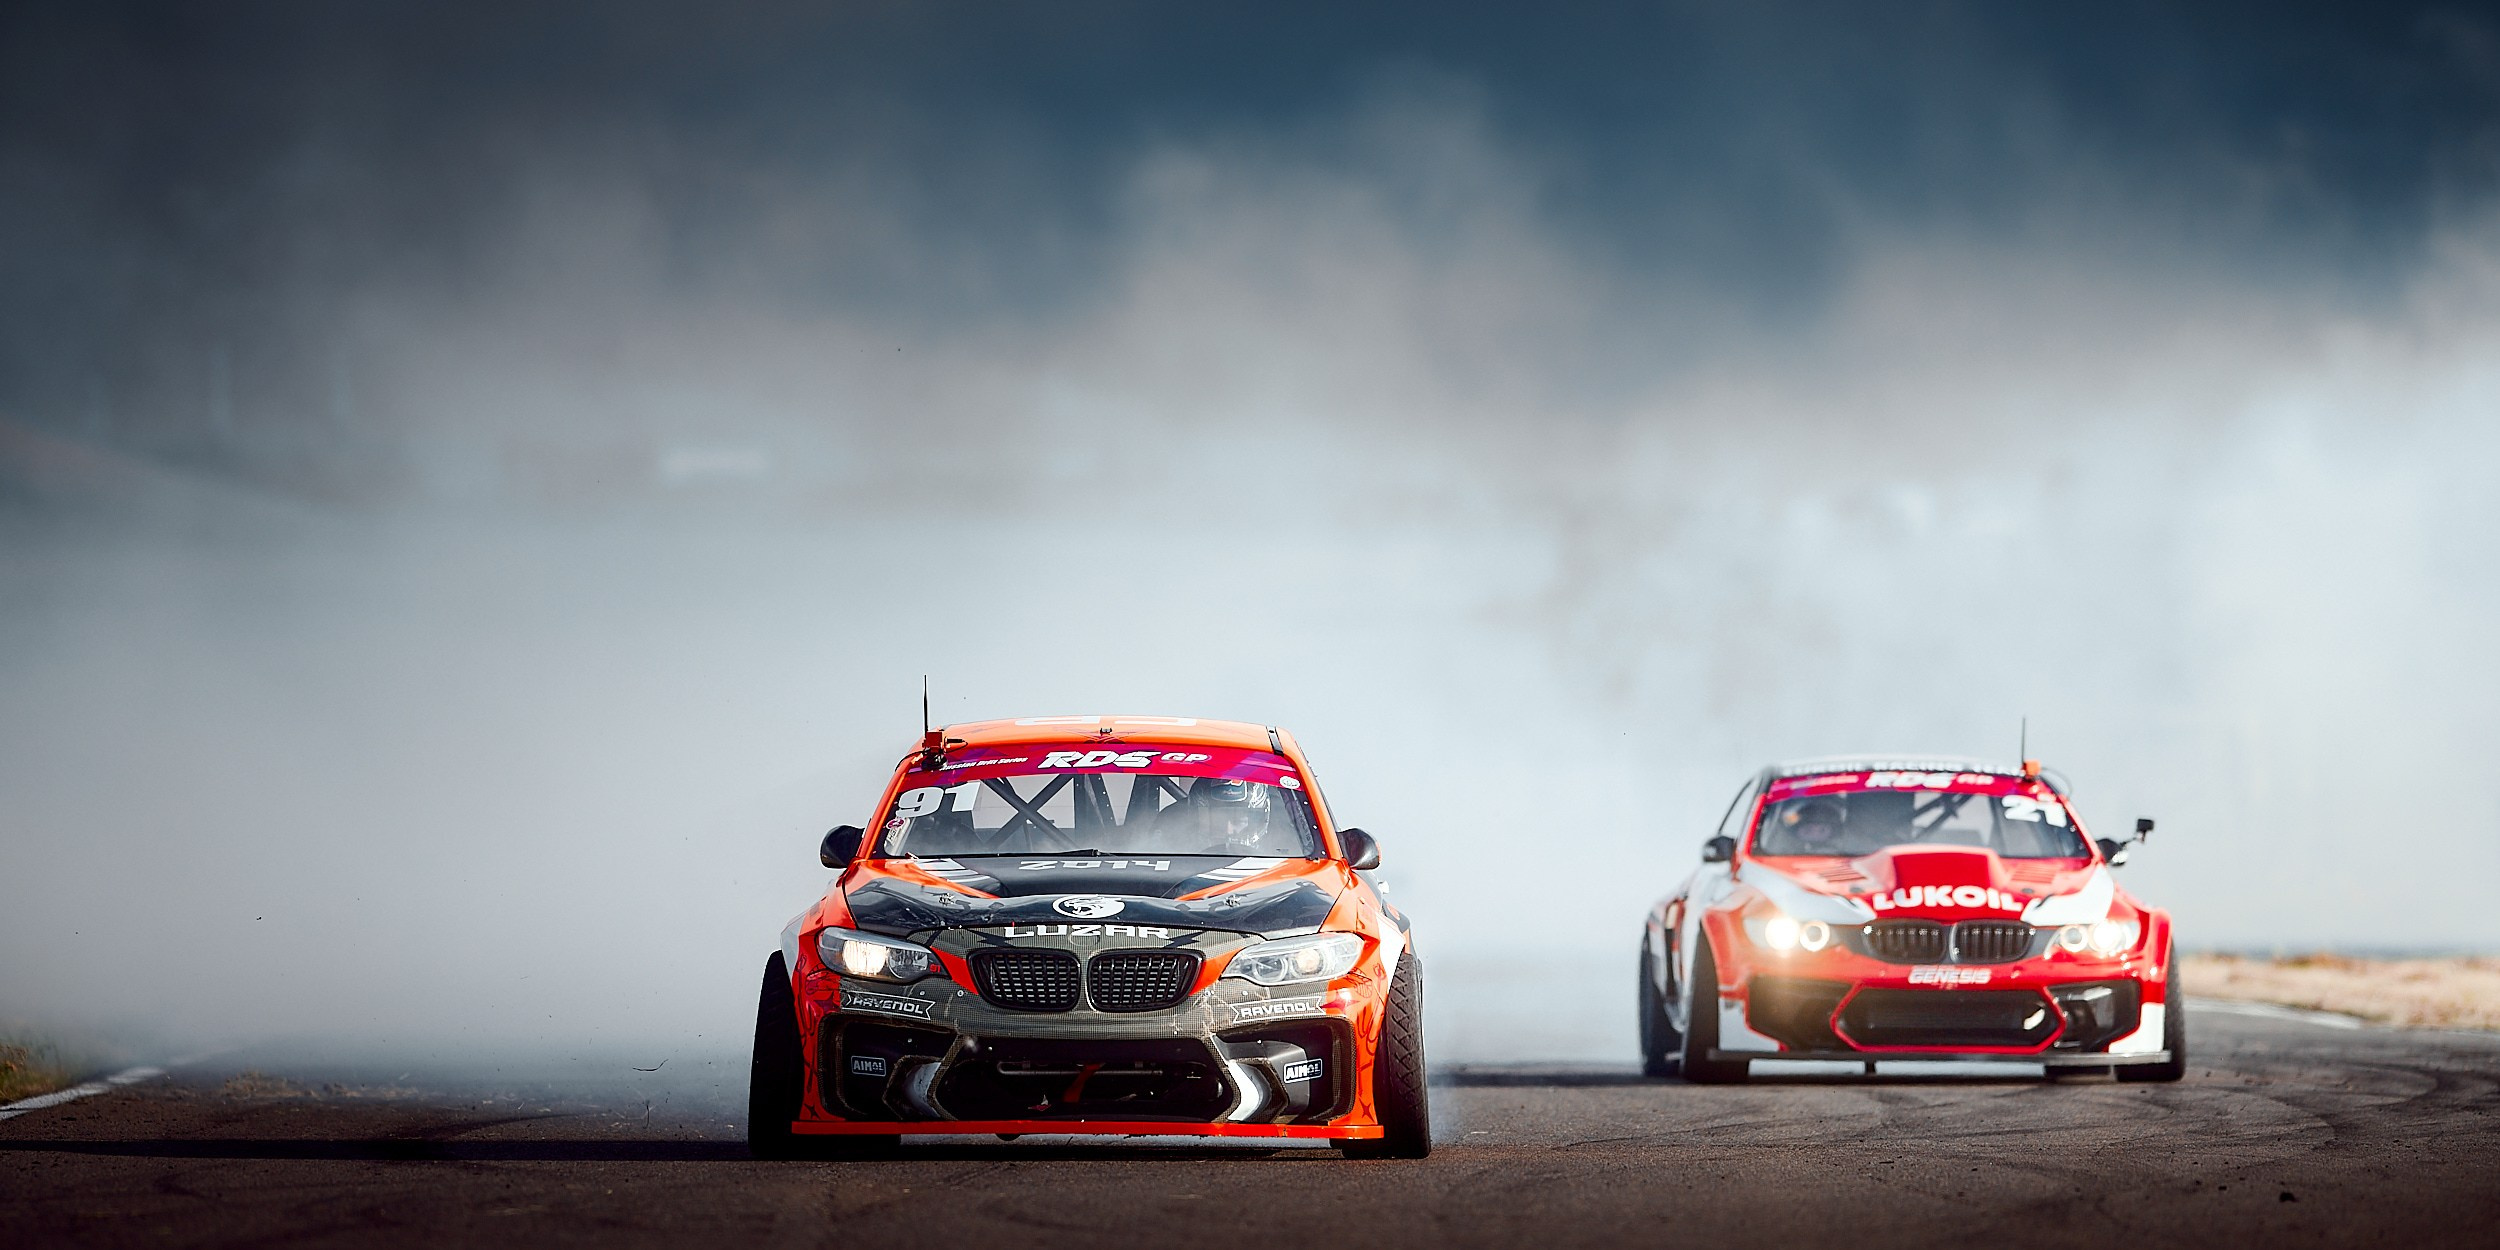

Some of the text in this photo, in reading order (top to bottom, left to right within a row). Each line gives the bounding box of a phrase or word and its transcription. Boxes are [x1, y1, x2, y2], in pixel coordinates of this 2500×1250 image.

[1037, 750, 1209, 769] RDS GP
[895, 779, 981, 818] 91
[2001, 794, 2067, 828] 21
[1018, 860, 1171, 871] 2014
[1872, 885, 2024, 912] LUKOIL
[1004, 924, 1170, 940] LUZAR
[1908, 965, 1992, 984] GENESIS
[852, 997, 924, 1015] RAVENOL
[1240, 1001, 1316, 1018] RAVENOL
